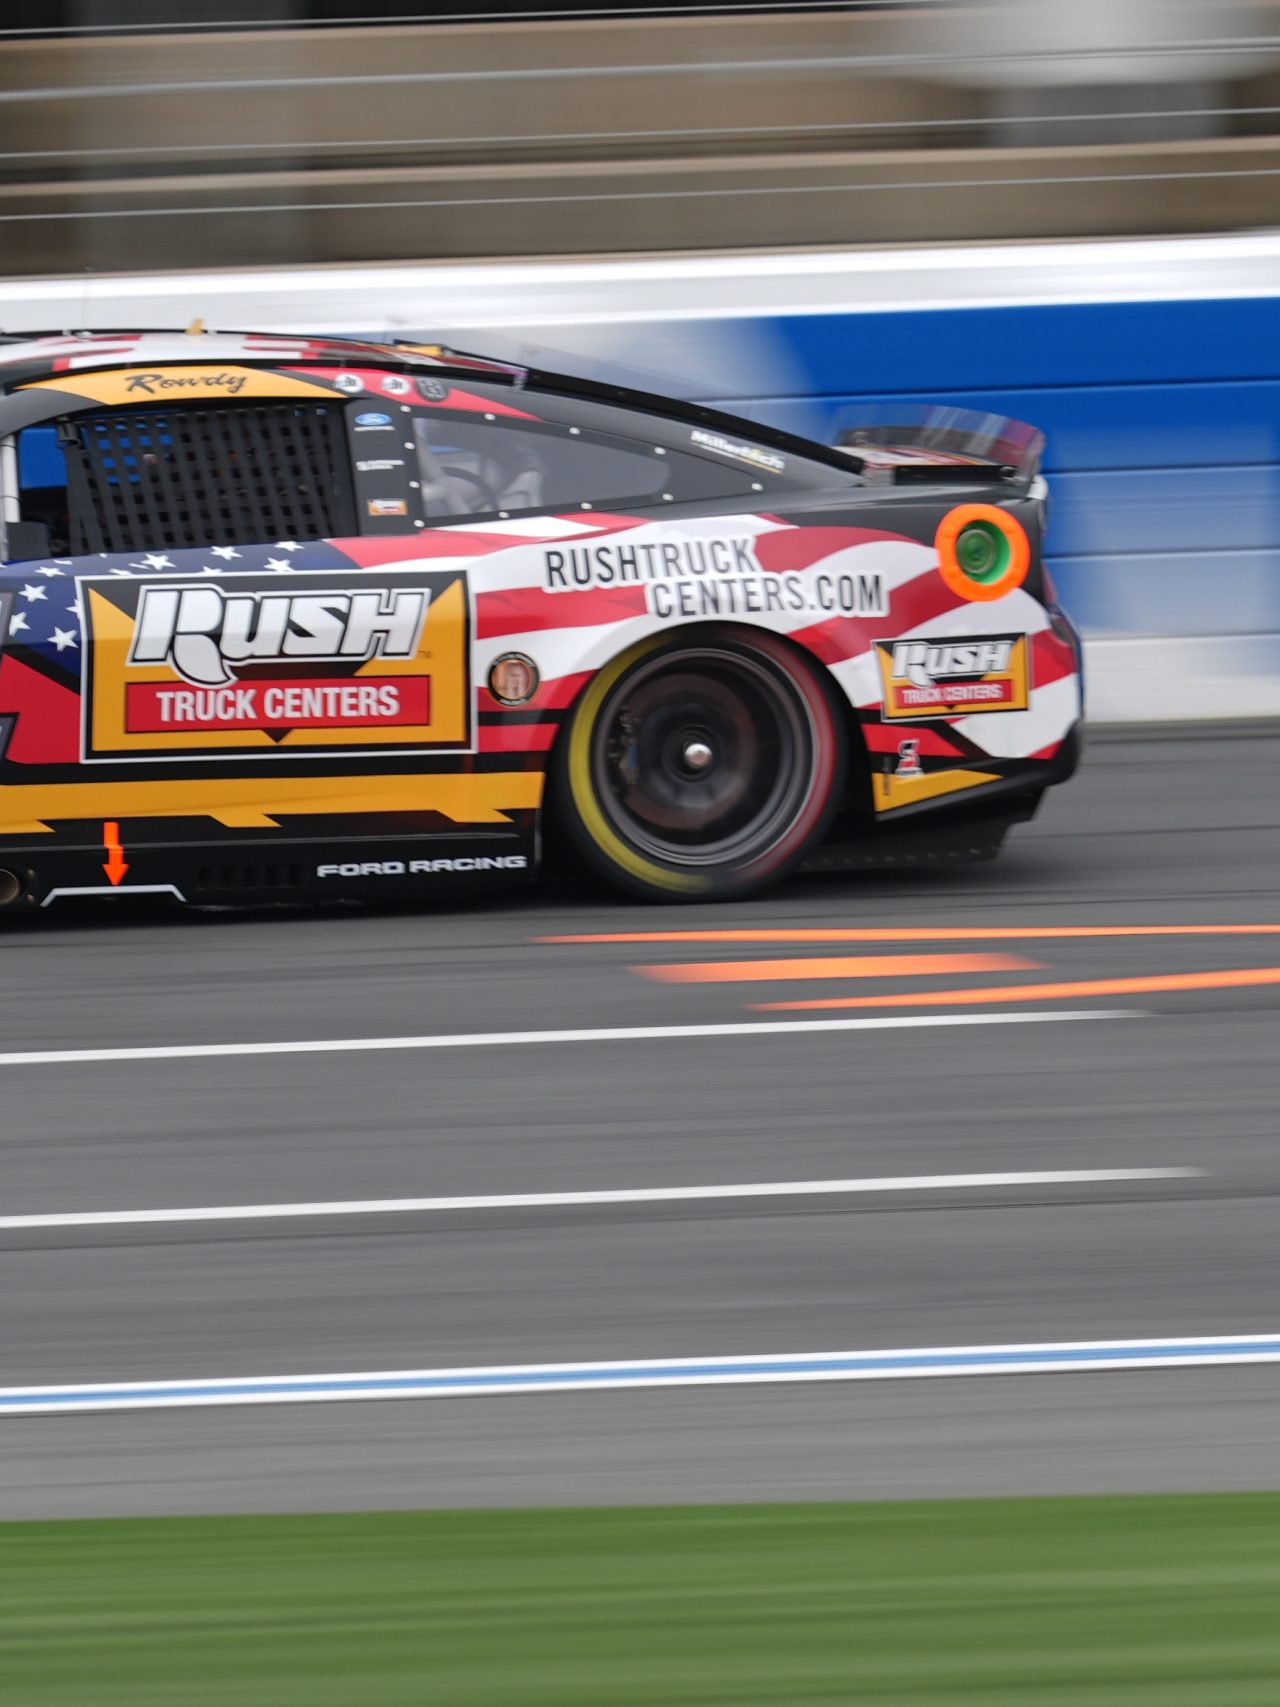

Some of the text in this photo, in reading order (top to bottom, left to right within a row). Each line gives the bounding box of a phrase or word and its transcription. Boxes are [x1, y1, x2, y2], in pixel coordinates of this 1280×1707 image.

[124, 373, 248, 394] Rowdy
[545, 538, 756, 587] RUSHTRUCK
[650, 574, 884, 618] CENTERS.COM
[128, 585, 429, 686] RUSH
[893, 640, 1015, 688] RUSH
[156, 685, 401, 722] TRUCK CENTERS
[902, 684, 1004, 704] TRUCK CENTERS
[317, 856, 528, 877] FORD RACING
